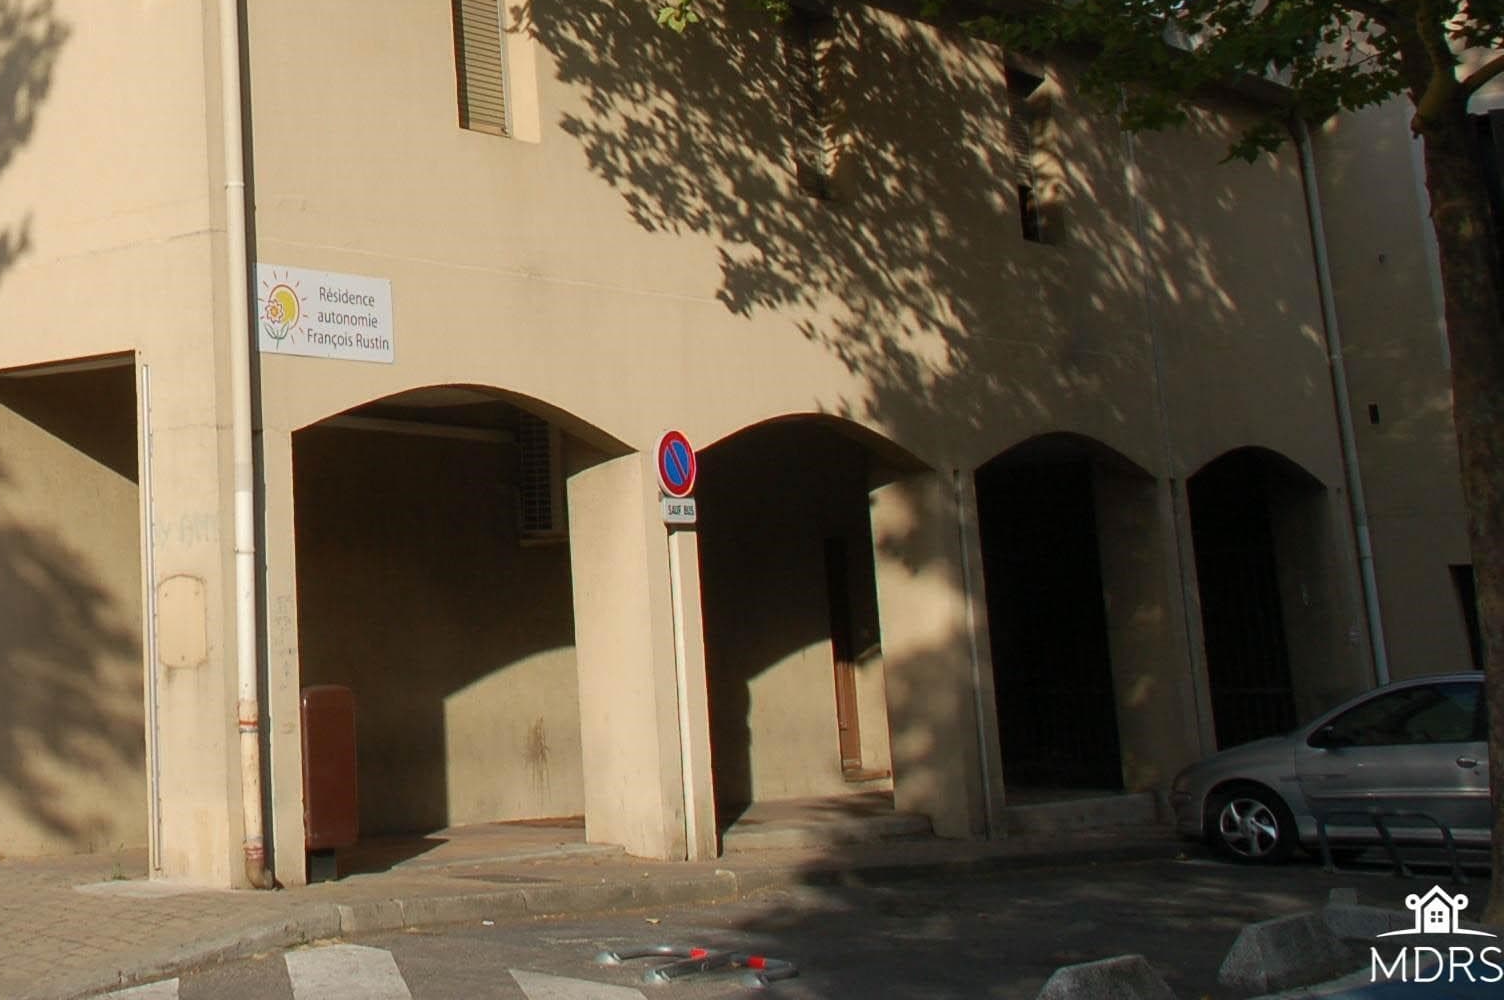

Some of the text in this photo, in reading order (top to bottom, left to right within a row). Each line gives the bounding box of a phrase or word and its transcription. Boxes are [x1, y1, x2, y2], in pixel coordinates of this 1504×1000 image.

[319, 286, 375, 307] Résidence
[318, 311, 378, 329] autonomie
[307, 328, 389, 351] François Rustin
[668, 505, 694, 516] SAUF BUS
